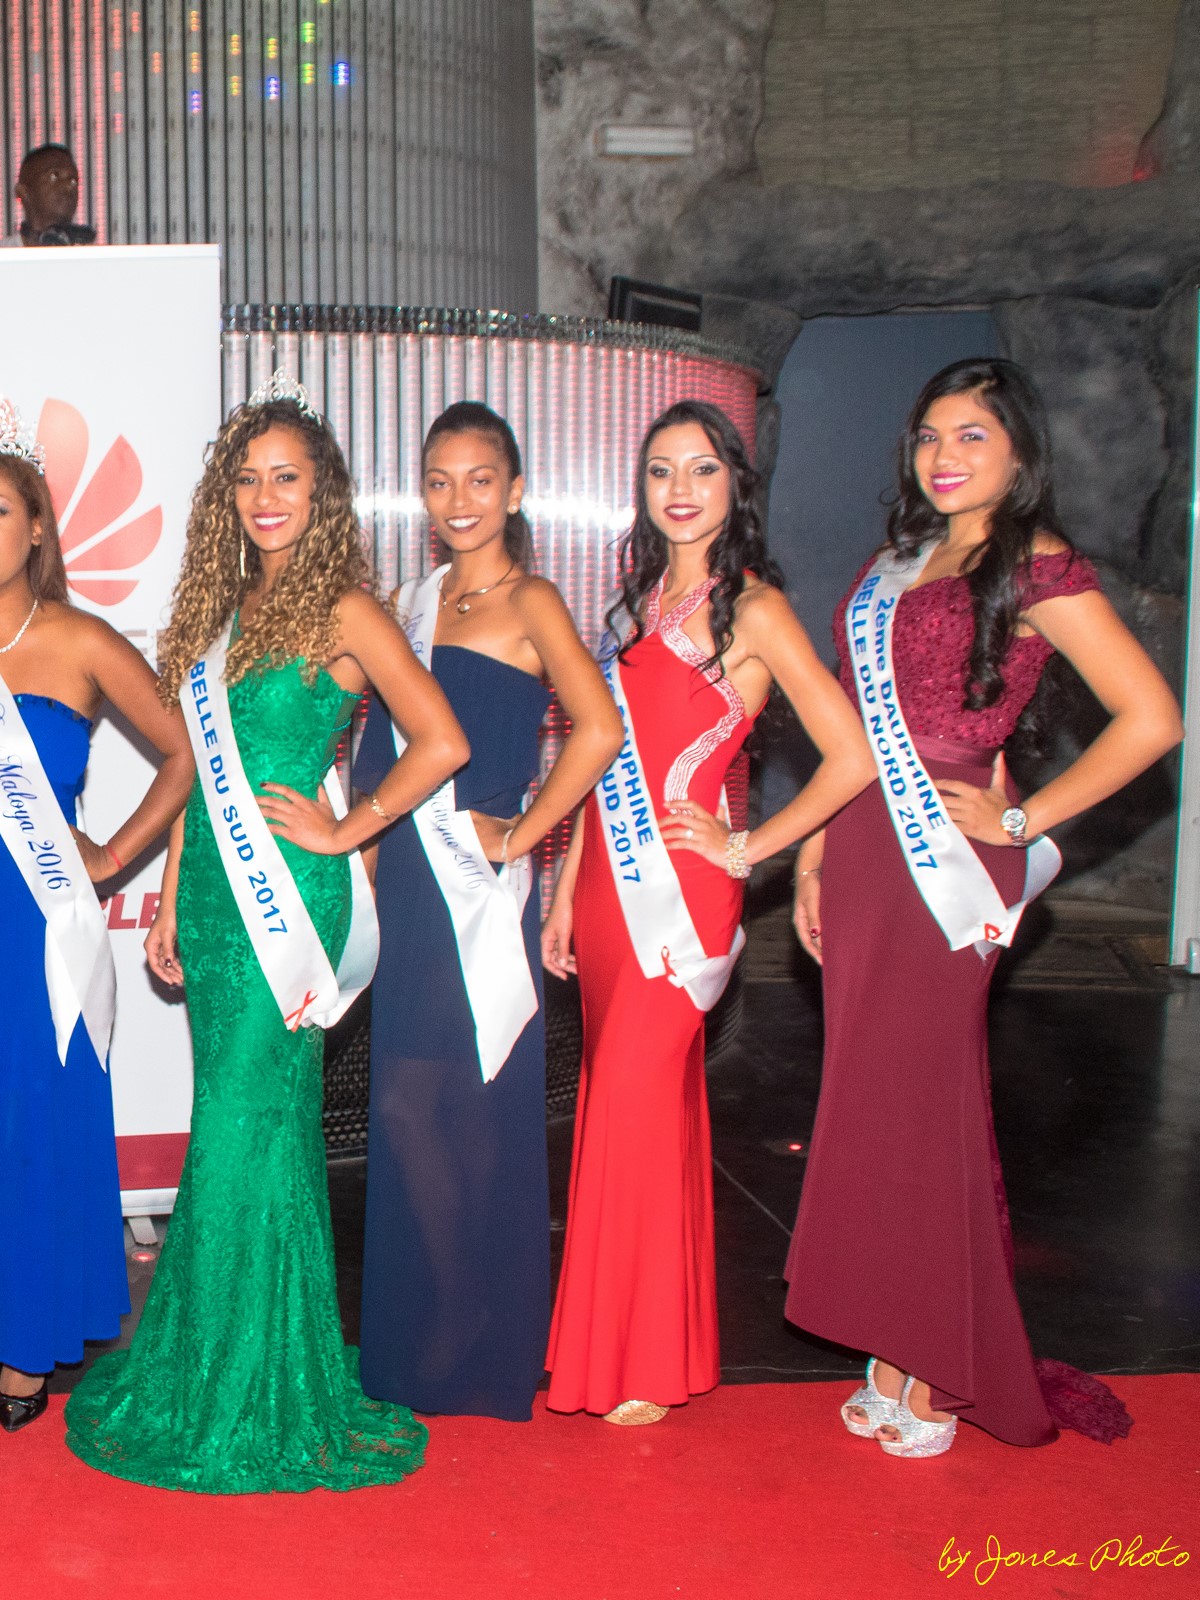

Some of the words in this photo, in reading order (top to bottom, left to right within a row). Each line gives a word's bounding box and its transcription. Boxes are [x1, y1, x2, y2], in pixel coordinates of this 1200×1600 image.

[851, 575, 881, 655] BELLE
[859, 664, 876, 704] DU
[870, 714, 906, 797] NORD
[881, 680, 947, 830] DAUPHINE
[190, 660, 217, 748] BELLE
[210, 754, 229, 794] DU
[222, 805, 254, 862] SUD
[247, 870, 287, 934] 2017
[28, 839, 71, 890] 2016
[610, 821, 641, 883] 2017
[897, 805, 938, 870] 2017
